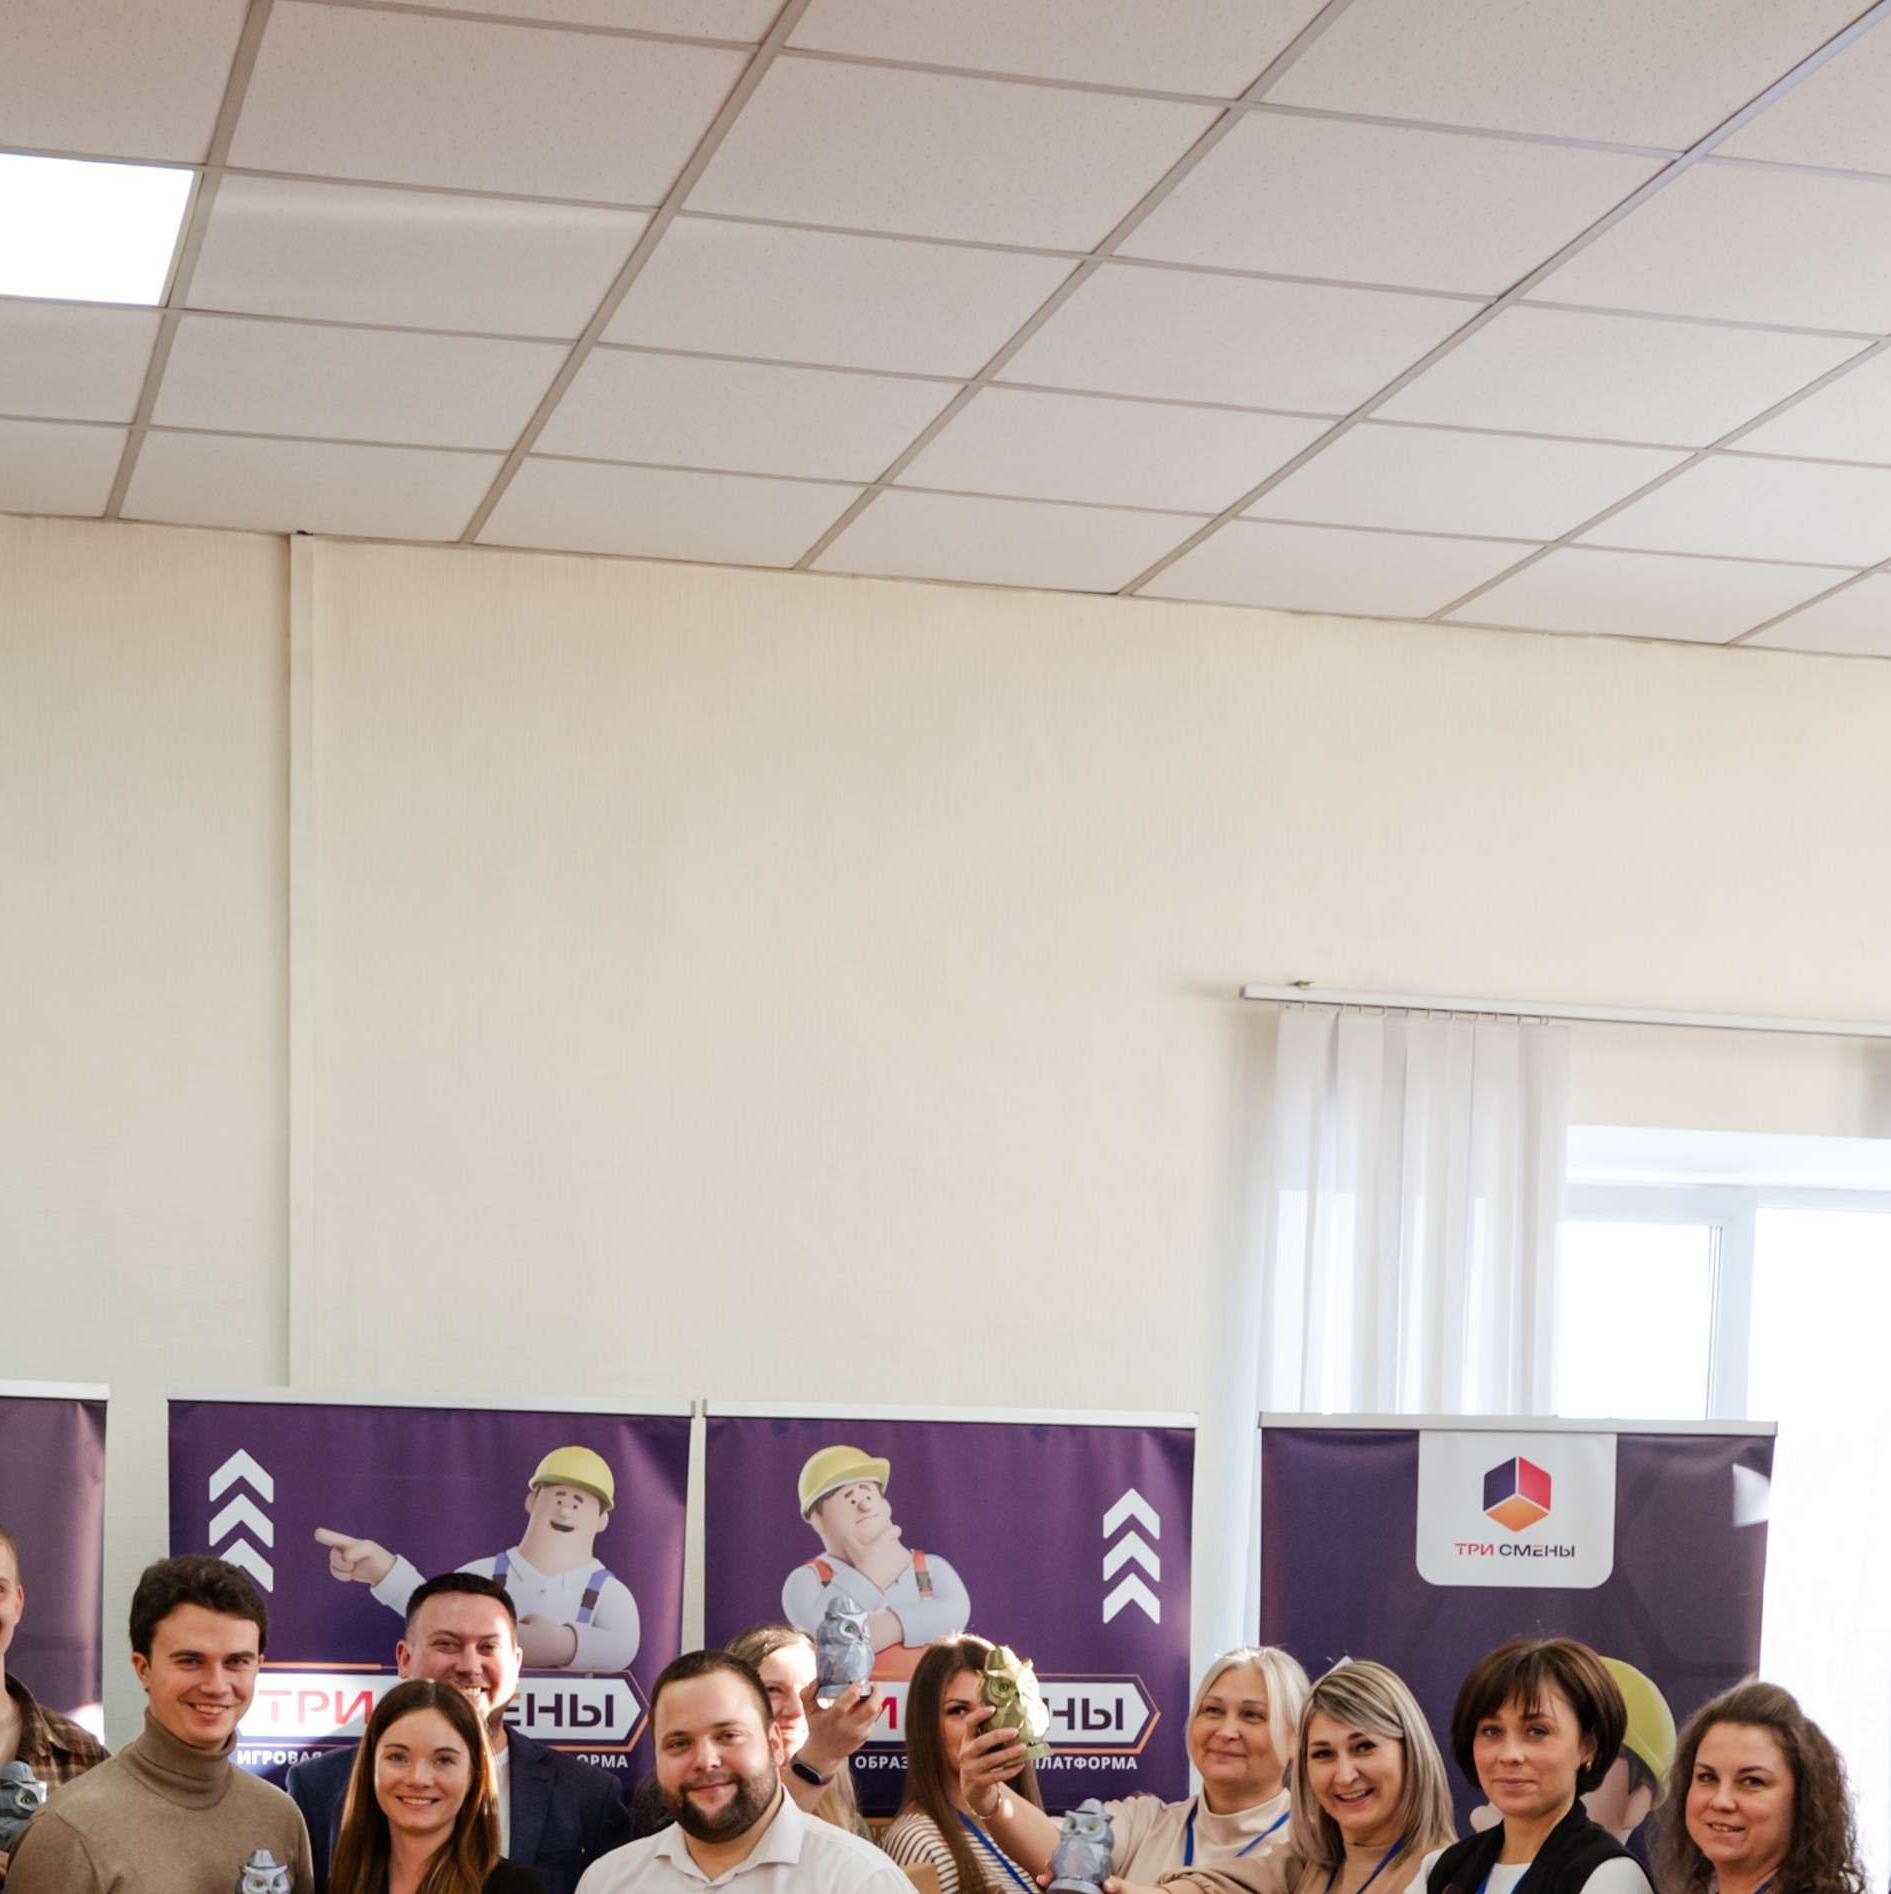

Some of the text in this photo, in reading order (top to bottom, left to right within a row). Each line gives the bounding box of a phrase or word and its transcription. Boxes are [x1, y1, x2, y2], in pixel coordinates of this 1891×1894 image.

[1454, 1542, 1576, 1558] ТРИ СМЕНЫ
[258, 1690, 614, 1728] ТРИ ЕНЫ
[1046, 1698, 1124, 1731] НЫ
[855, 1755, 908, 1770] ОБРАЗ
